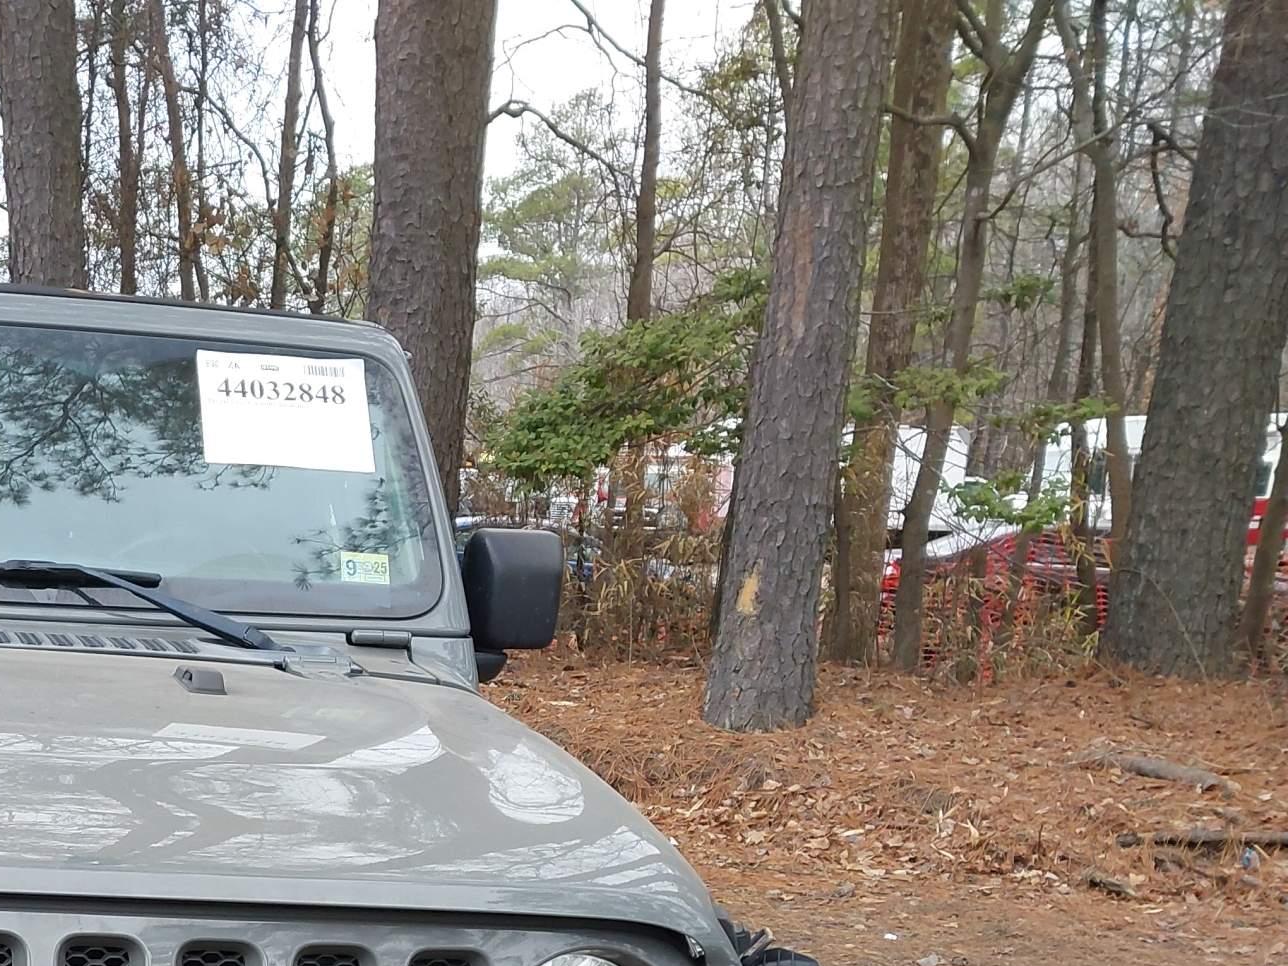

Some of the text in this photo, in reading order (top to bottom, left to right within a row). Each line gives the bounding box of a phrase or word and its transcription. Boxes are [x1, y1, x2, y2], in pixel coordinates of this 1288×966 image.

[217, 377, 346, 404] 44032848
[345, 559, 387, 576] 9 25
